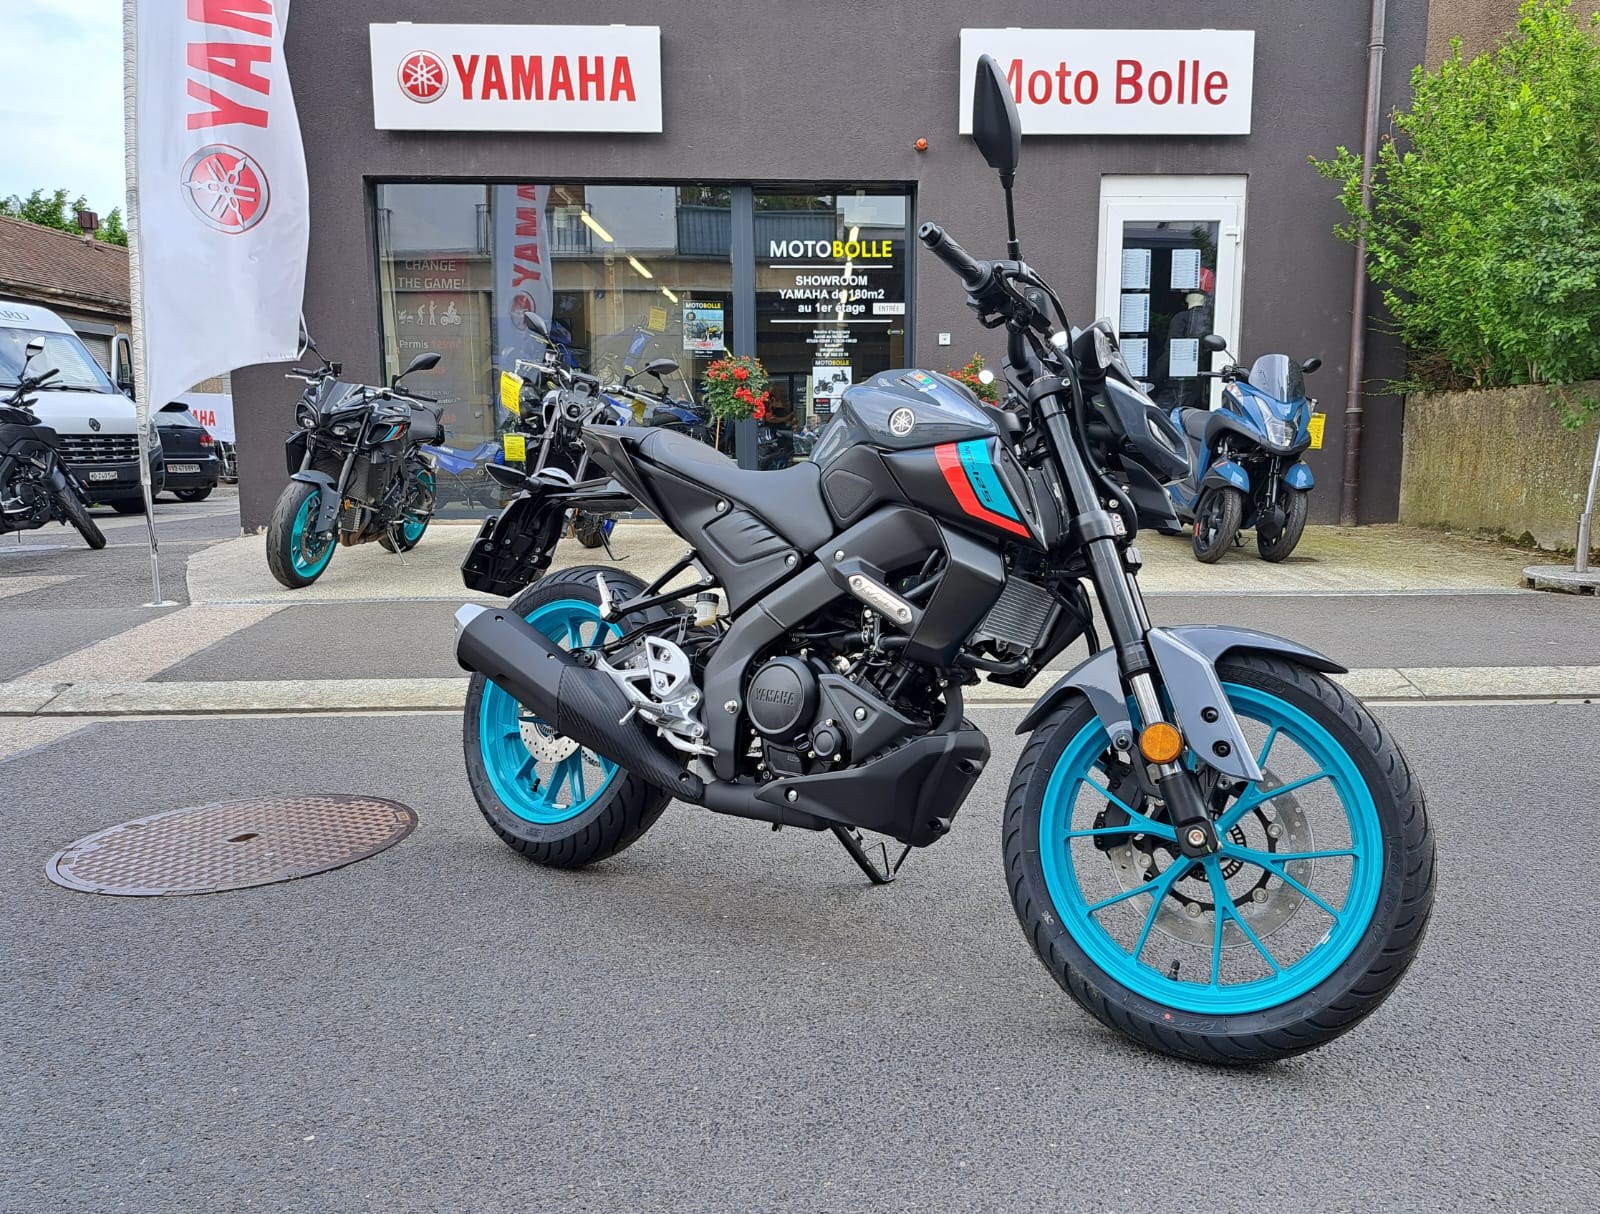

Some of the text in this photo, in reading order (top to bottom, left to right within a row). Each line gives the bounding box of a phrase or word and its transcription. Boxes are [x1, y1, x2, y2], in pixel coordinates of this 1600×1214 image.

[452, 55, 636, 101] YAMAHA
[1115, 59, 1228, 105] Bolle
[769, 240, 893, 258] MOTOBOLLE
[405, 260, 457, 272] CHANGE
[398, 277, 465, 290] THE GAME!
[795, 275, 868, 286] SHOWROOM
[779, 289, 885, 299] YAMAHA de 180m2
[798, 303, 866, 315] au 1er étage
[399, 339, 429, 349] Permis
[755, 687, 797, 705] YAMAHA
